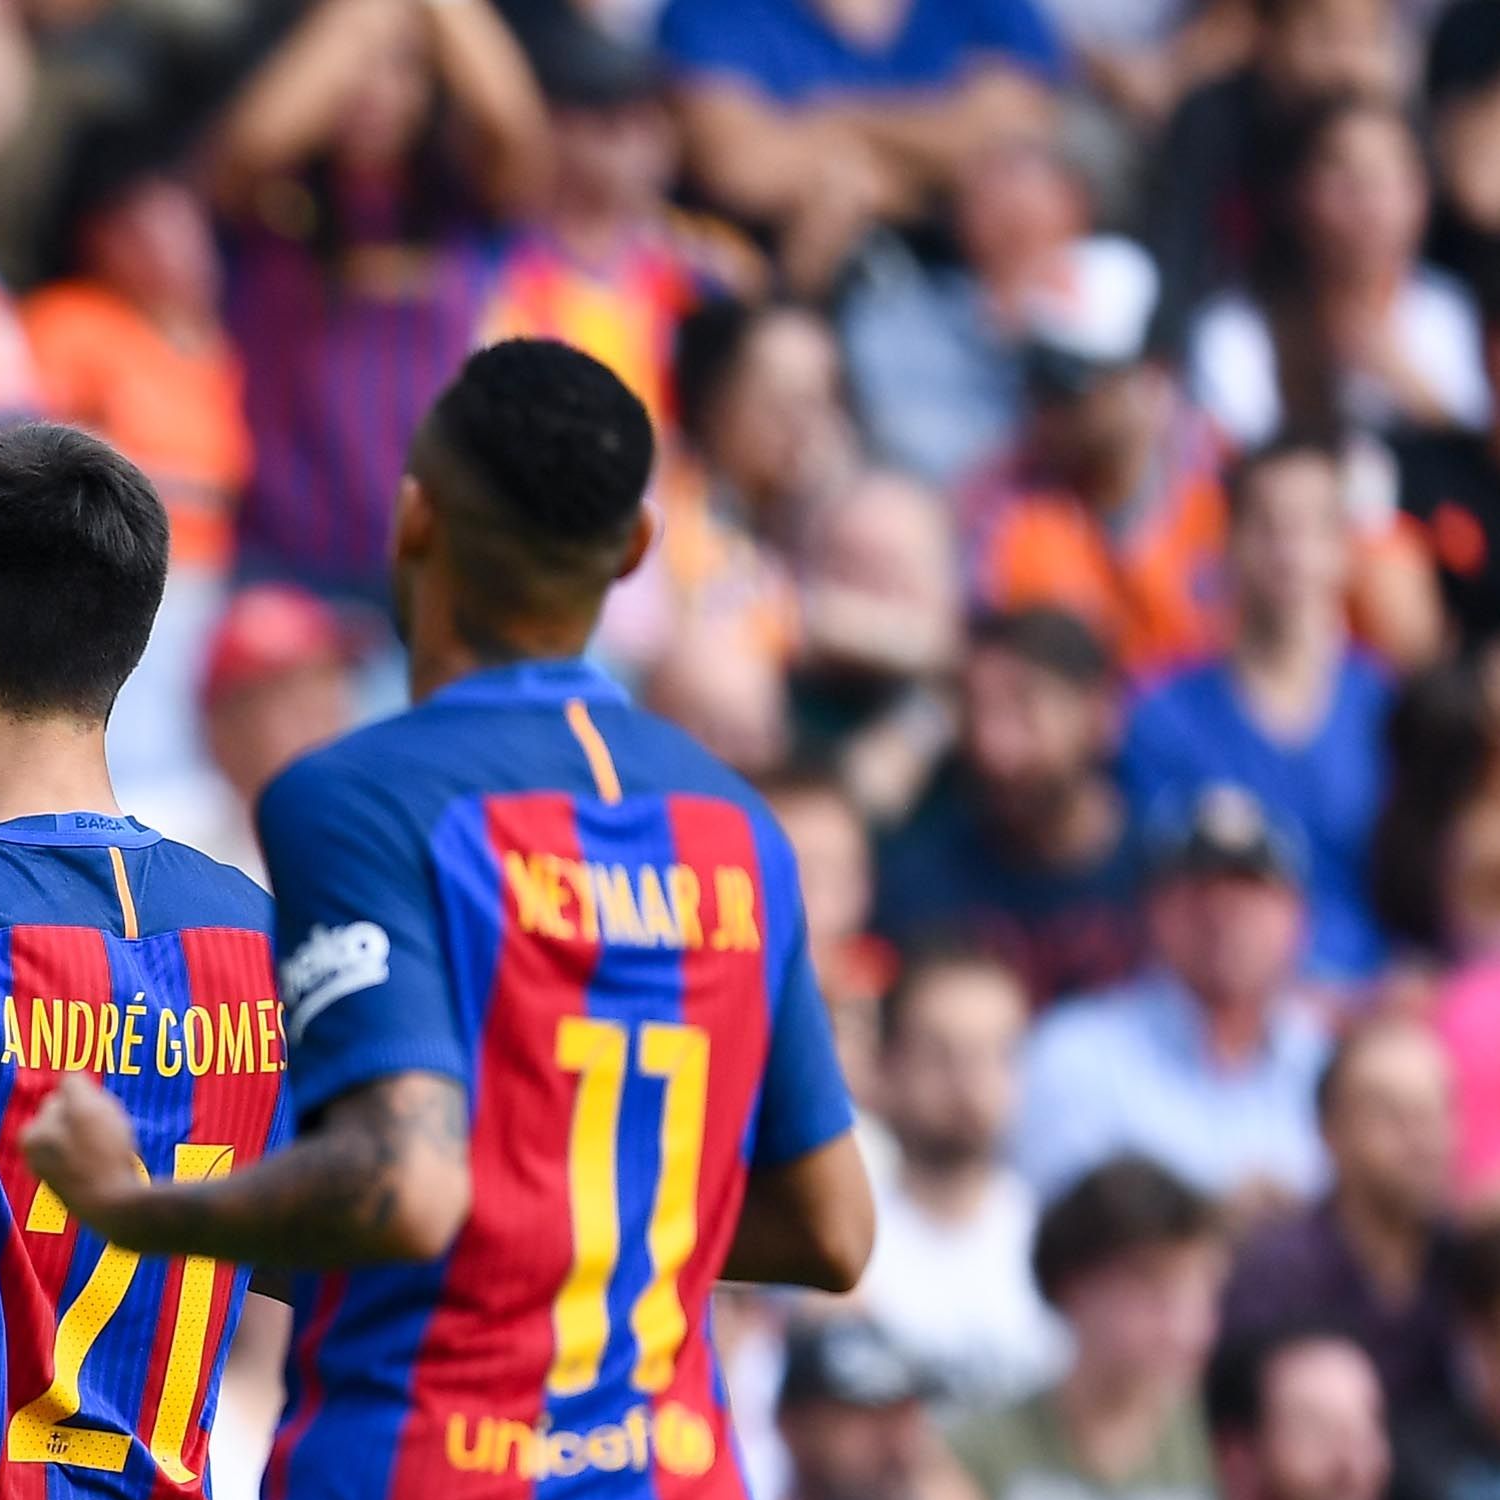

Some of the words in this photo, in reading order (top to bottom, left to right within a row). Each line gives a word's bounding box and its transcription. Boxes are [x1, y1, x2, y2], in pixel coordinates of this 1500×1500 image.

[74, 815, 126, 834] BARÇA
[503, 849, 703, 950] NEYMAR
[711, 863, 759, 953] JR
[1, 991, 147, 1076] ANDRÉ
[543, 1016, 711, 1397] 11
[7, 1143, 236, 1482] 21
[445, 1403, 650, 1482] unicef
